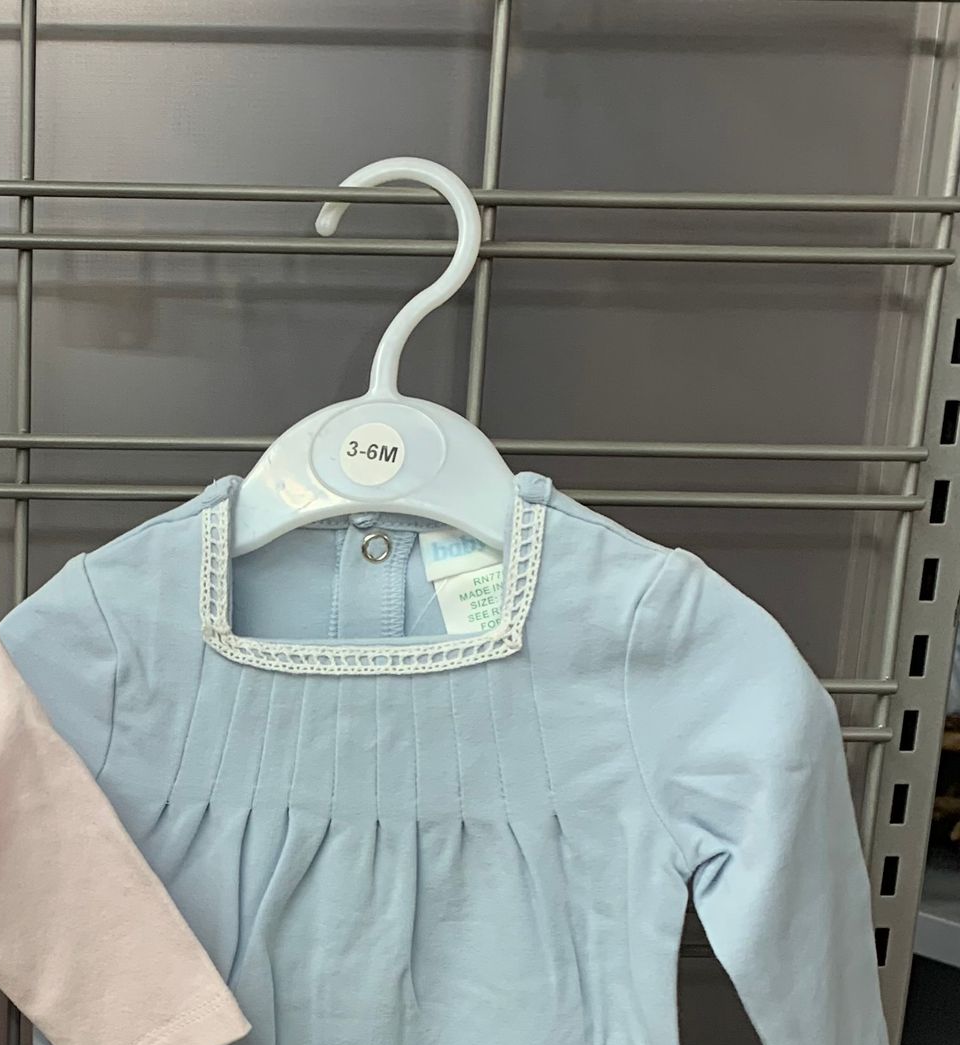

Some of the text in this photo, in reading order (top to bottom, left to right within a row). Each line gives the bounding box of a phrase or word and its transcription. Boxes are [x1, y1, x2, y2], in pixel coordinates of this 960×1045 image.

[346, 440, 399, 464] 3-6M
[459, 587, 490, 602] MADE
[467, 609, 490, 622] SEE
